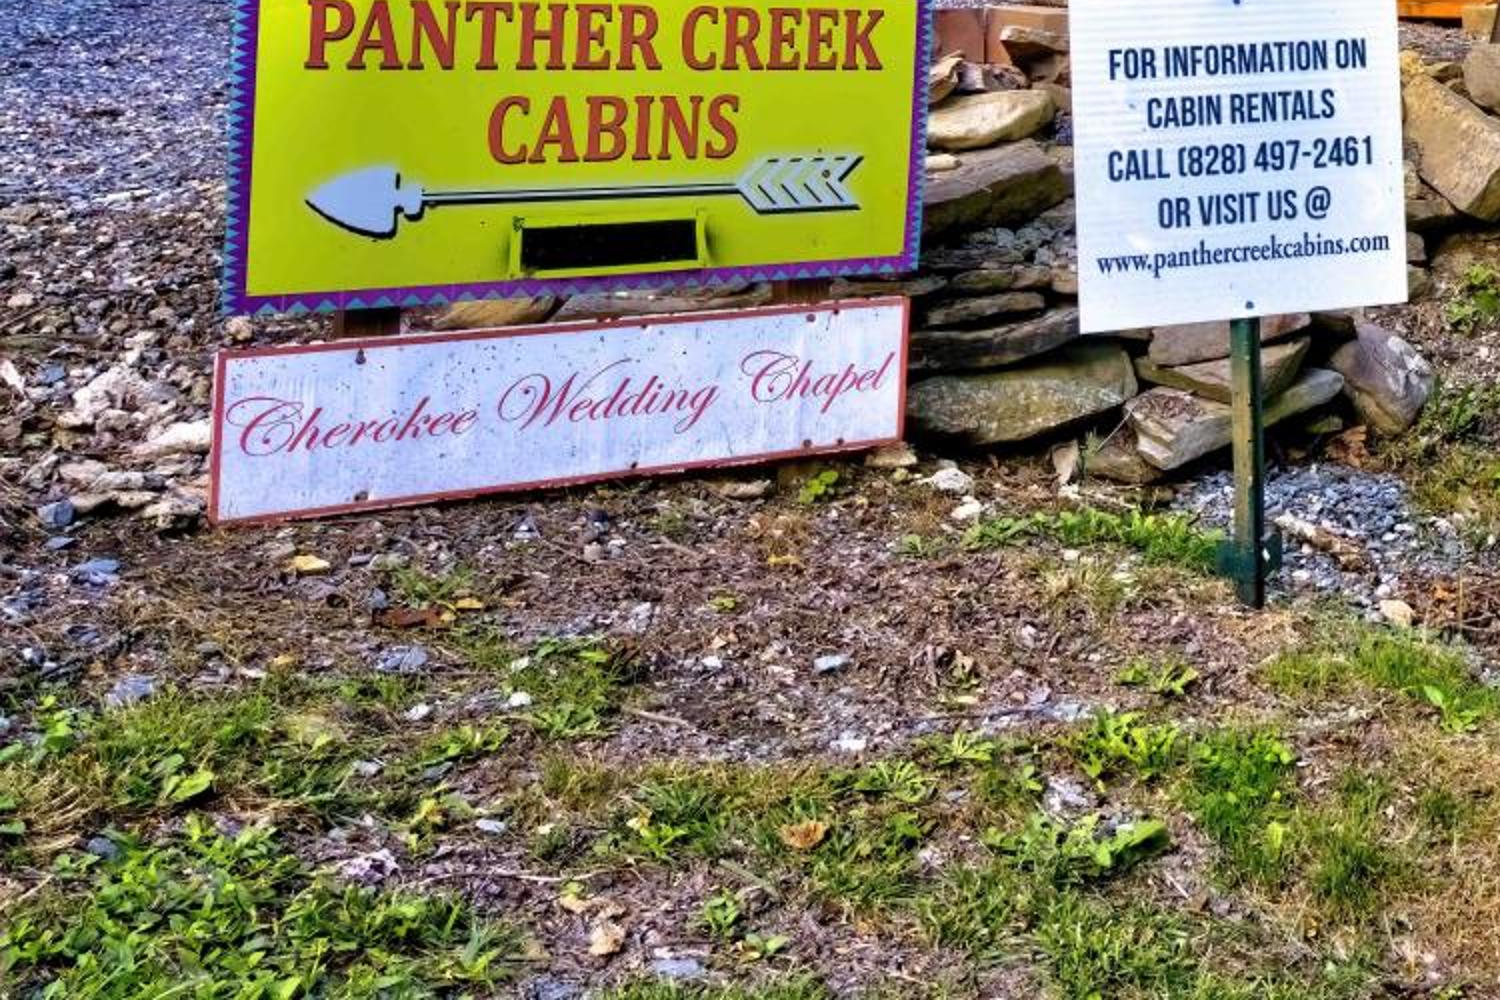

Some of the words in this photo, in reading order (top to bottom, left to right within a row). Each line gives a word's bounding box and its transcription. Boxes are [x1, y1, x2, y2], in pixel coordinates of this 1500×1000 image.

[681, 5, 885, 70] CREEK
[1109, 47, 1156, 80] FOR
[1165, 41, 1328, 77] INFORMATION
[1336, 38, 1367, 69] ON
[487, 94, 740, 164] CABINS
[1147, 95, 1222, 128] CABIN
[1231, 88, 1335, 124] RENTALS
[1108, 148, 1170, 182] CALL
[1178, 143, 1246, 177] (828)
[1254, 135, 1373, 172] 497-2461
[1158, 196, 1191, 229] OR
[1198, 192, 1260, 226] VISIT
[1267, 190, 1297, 221] US
[1305, 186, 1332, 219] @
[1097, 232, 1390, 278] www.panthercreekcabins.com
[226, 396, 478, 457] Cherokee
[498, 358, 721, 430] Wedding
[740, 350, 896, 413] Chapel
